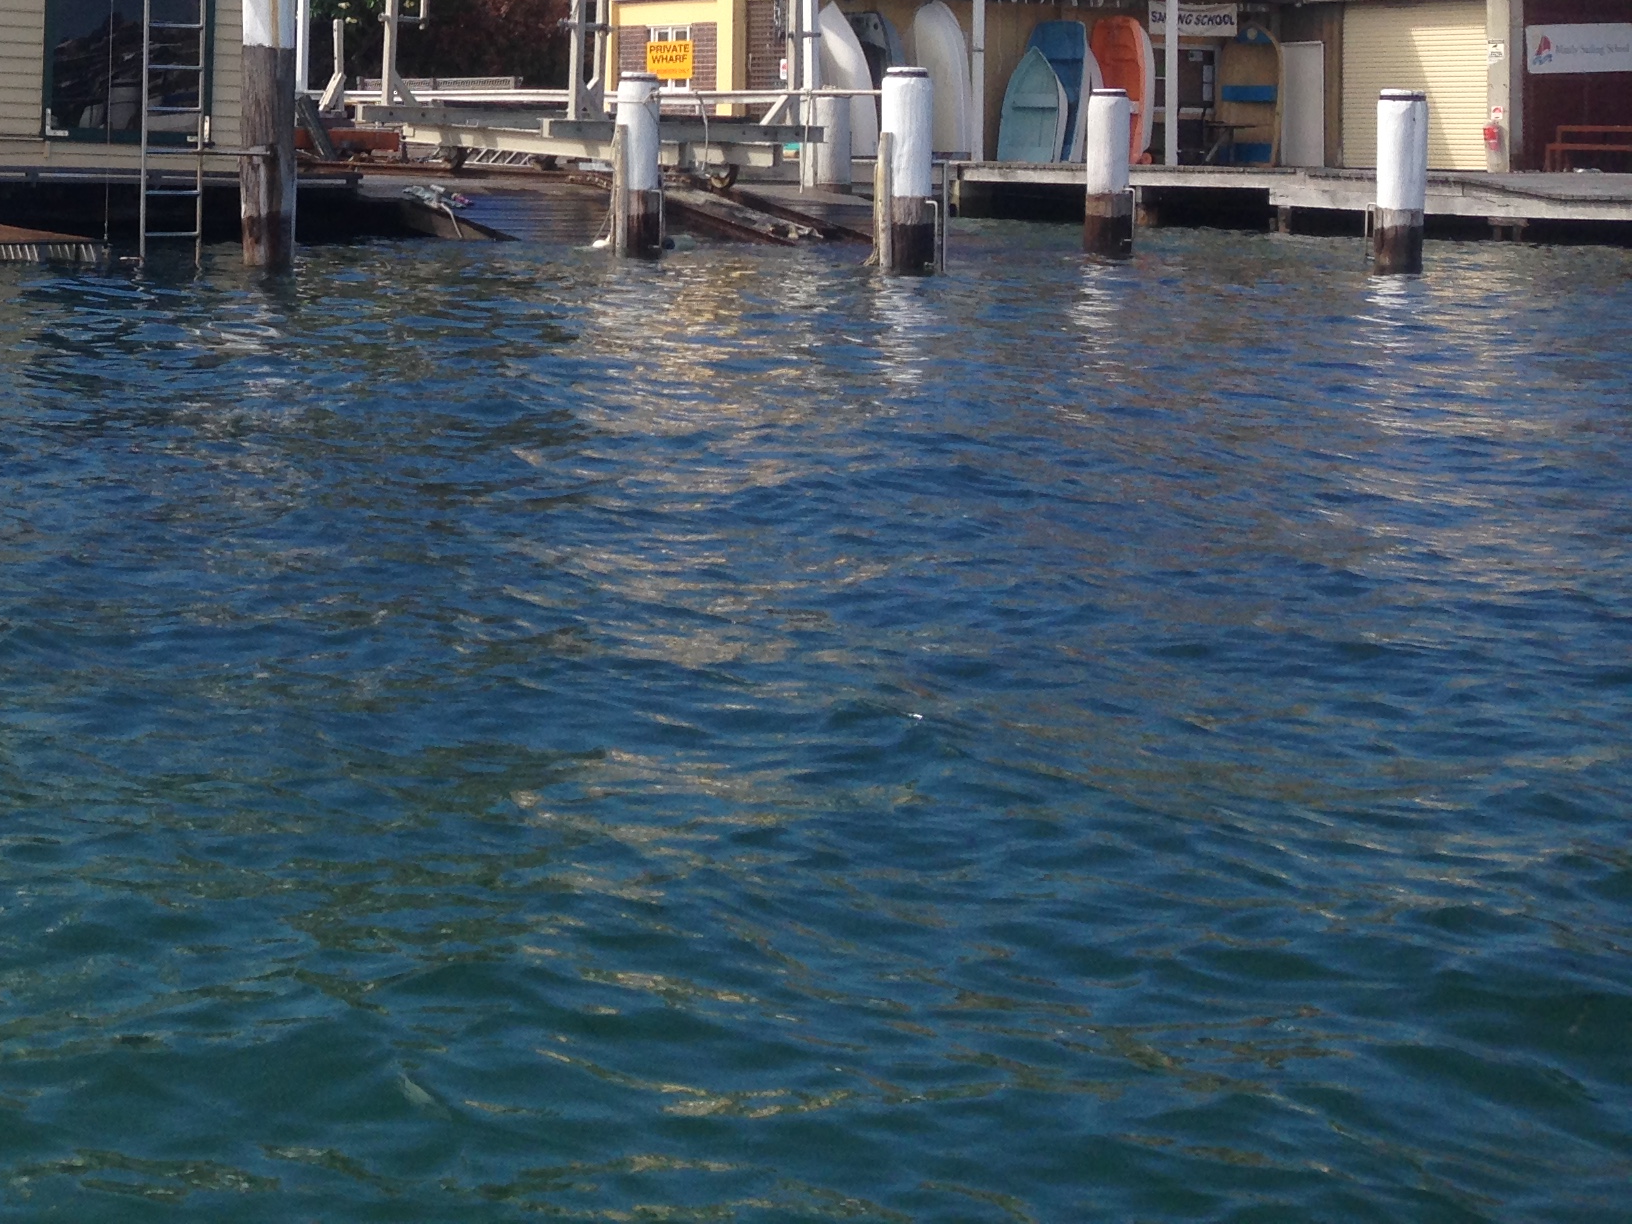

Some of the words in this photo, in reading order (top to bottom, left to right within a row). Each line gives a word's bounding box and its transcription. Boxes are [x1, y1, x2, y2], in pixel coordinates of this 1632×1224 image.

[1194, 12, 1235, 26] SCHOOL
[649, 44, 689, 53] PRIVATE
[652, 54, 687, 63] WHARF
